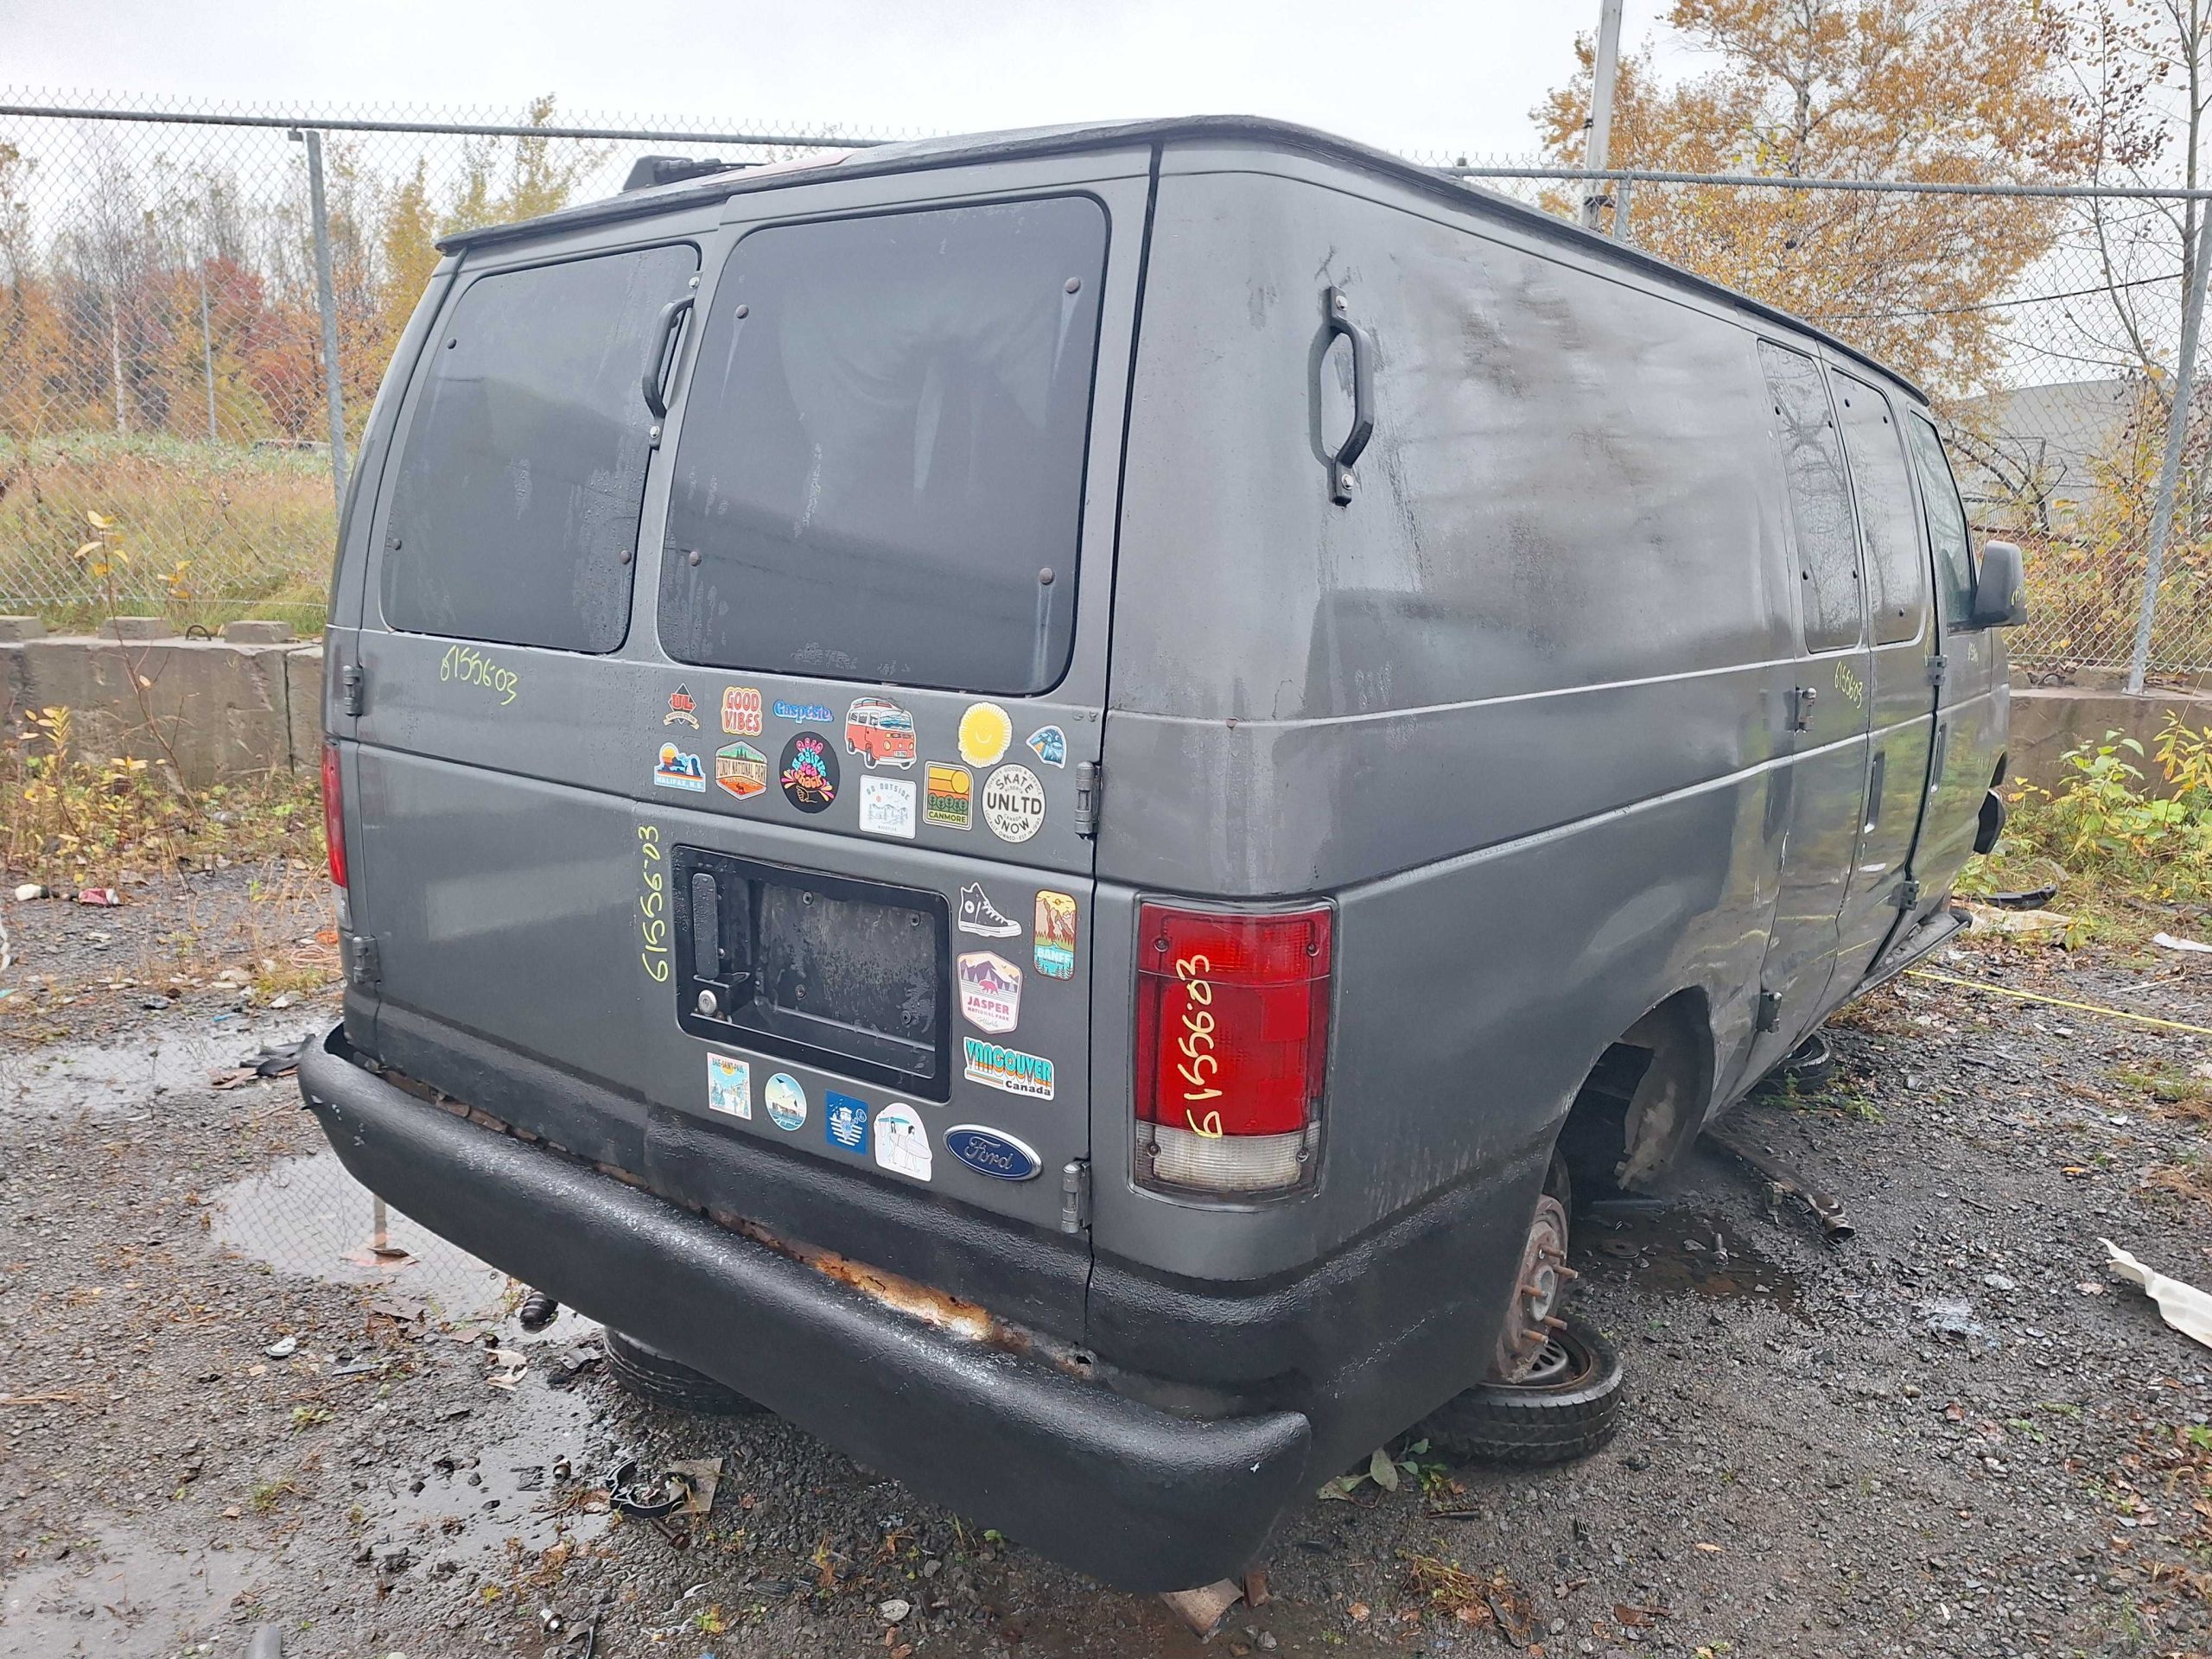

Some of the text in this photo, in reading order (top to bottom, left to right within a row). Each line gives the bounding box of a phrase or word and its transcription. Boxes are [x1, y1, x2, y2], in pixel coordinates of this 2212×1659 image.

[727, 690, 760, 712] GOOD
[724, 710, 760, 733] VIBES
[732, 760, 753, 779] NATIONAL
[754, 763, 766, 785] PARK
[880, 783, 911, 801] OUTSIDE
[995, 773, 1034, 794] SKATE
[1004, 785, 1023, 794] ALBERTA
[987, 791, 1043, 816] UNLTD
[928, 810, 966, 823] CANMORE
[994, 814, 1030, 835] SNOW
[1003, 813, 1022, 822] CANADA
[1037, 947, 1072, 963] BANFF
[967, 1007, 995, 1018] NATIONAL
[968, 996, 1009, 1015] JASPER
[965, 1038, 1052, 1087] VANCOUVER
[1005, 1080, 1052, 1096] Canada
[964, 1135, 1014, 1170] Ford
